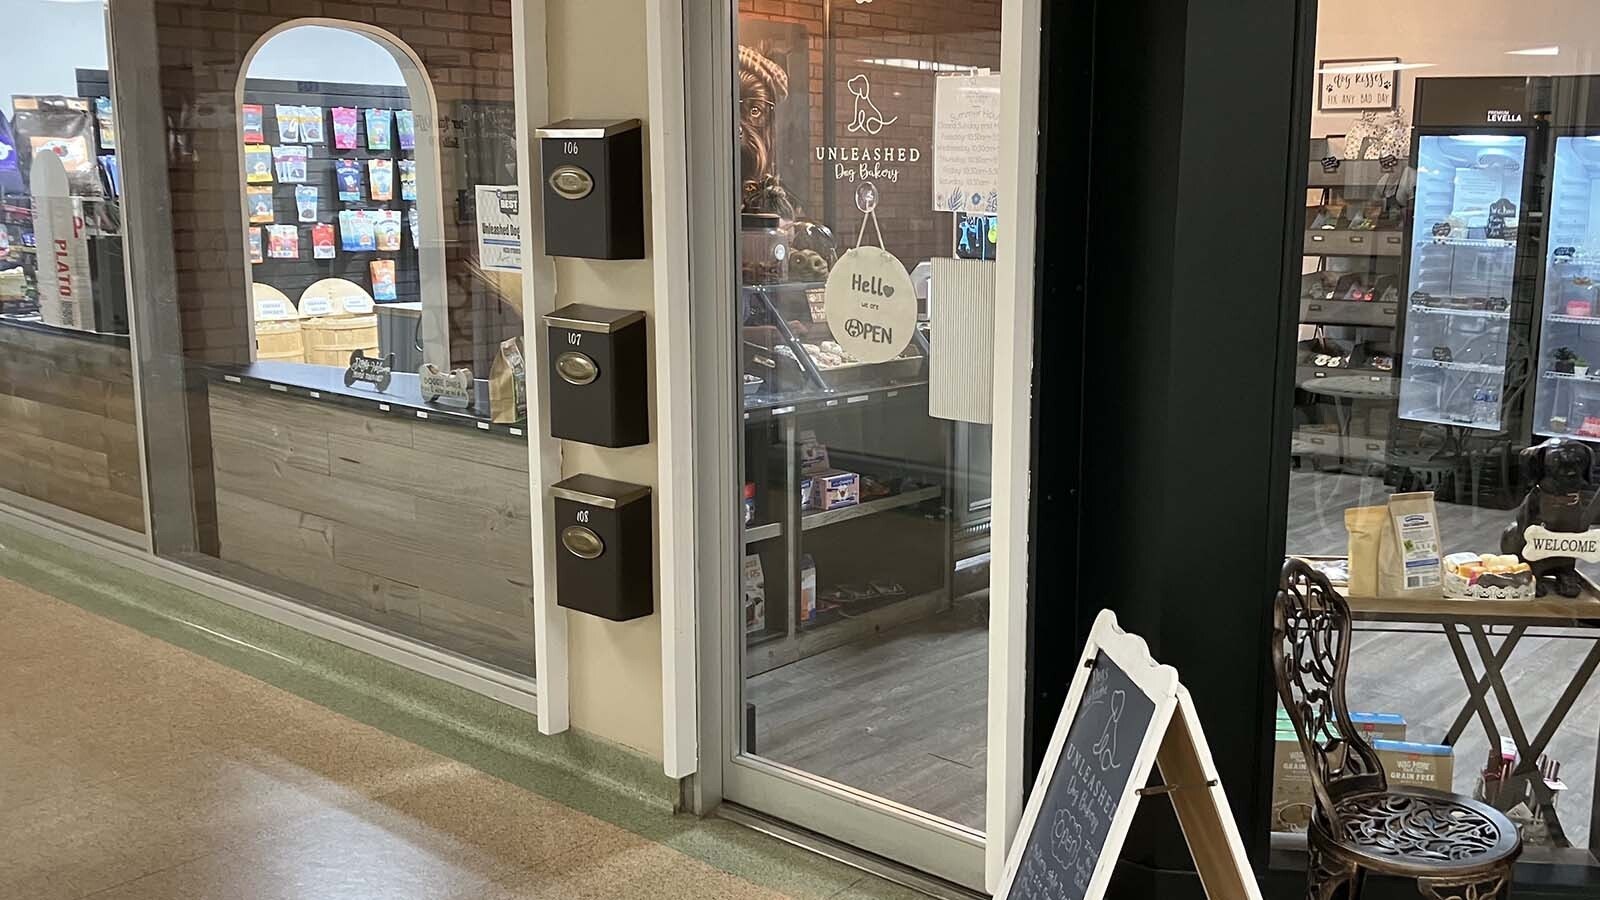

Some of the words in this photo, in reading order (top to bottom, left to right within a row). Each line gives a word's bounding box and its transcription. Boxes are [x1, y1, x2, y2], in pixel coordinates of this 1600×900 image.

[1327, 95, 1338, 105] FIX
[1342, 94, 1355, 105] ANY
[1360, 93, 1373, 104] BAD
[1377, 92, 1390, 104] DAY
[564, 141, 579, 154] 106
[816, 146, 920, 162] UNLEASHED
[835, 163, 856, 182] Dog
[859, 162, 899, 182] Bakery
[501, 199, 518, 209] BEST
[482, 222, 509, 235] Unleashed
[54, 239, 72, 297] PLATO
[845, 319, 892, 344] OPEN
[567, 332, 582, 346] 107
[576, 510, 589, 523] 108
[1533, 537, 1597, 553] WELCOME
[1390, 772, 1415, 780] GRAIN
[1415, 774, 1435, 782] FREE
